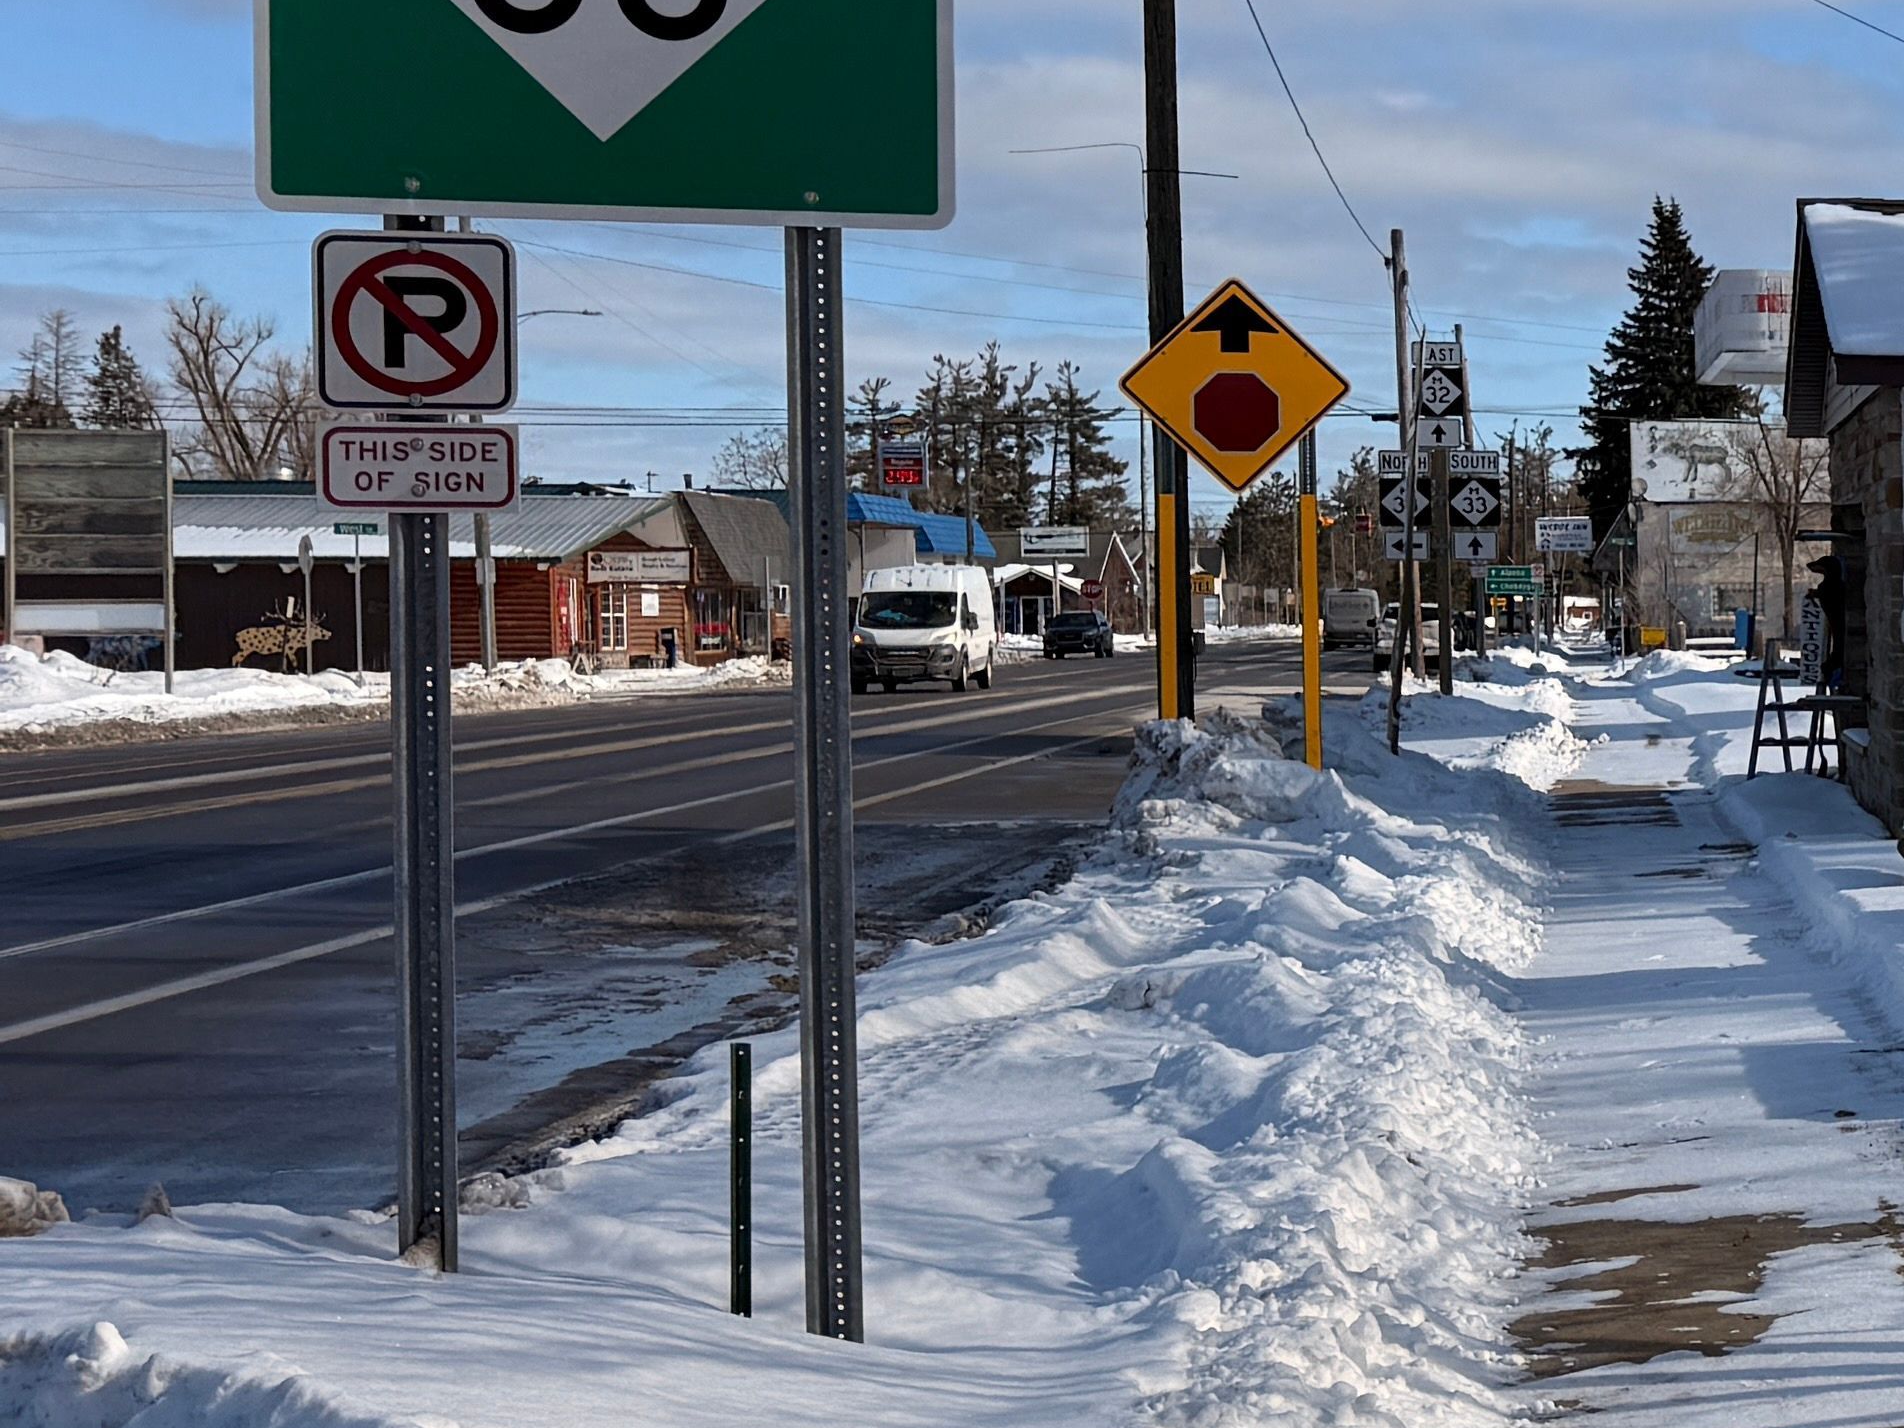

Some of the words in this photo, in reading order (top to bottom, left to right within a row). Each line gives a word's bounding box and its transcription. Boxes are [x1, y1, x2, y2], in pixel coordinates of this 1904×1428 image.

[1428, 348, 1455, 362] AST
[1425, 386, 1450, 404] 32
[339, 440, 410, 462] THIS
[428, 441, 498, 462] SIDE
[1451, 454, 1497, 470] SOUTH
[355, 471, 394, 492] OF
[414, 471, 484, 493] SIGN
[1393, 496, 1418, 514] 3
[1462, 497, 1488, 514] 33
